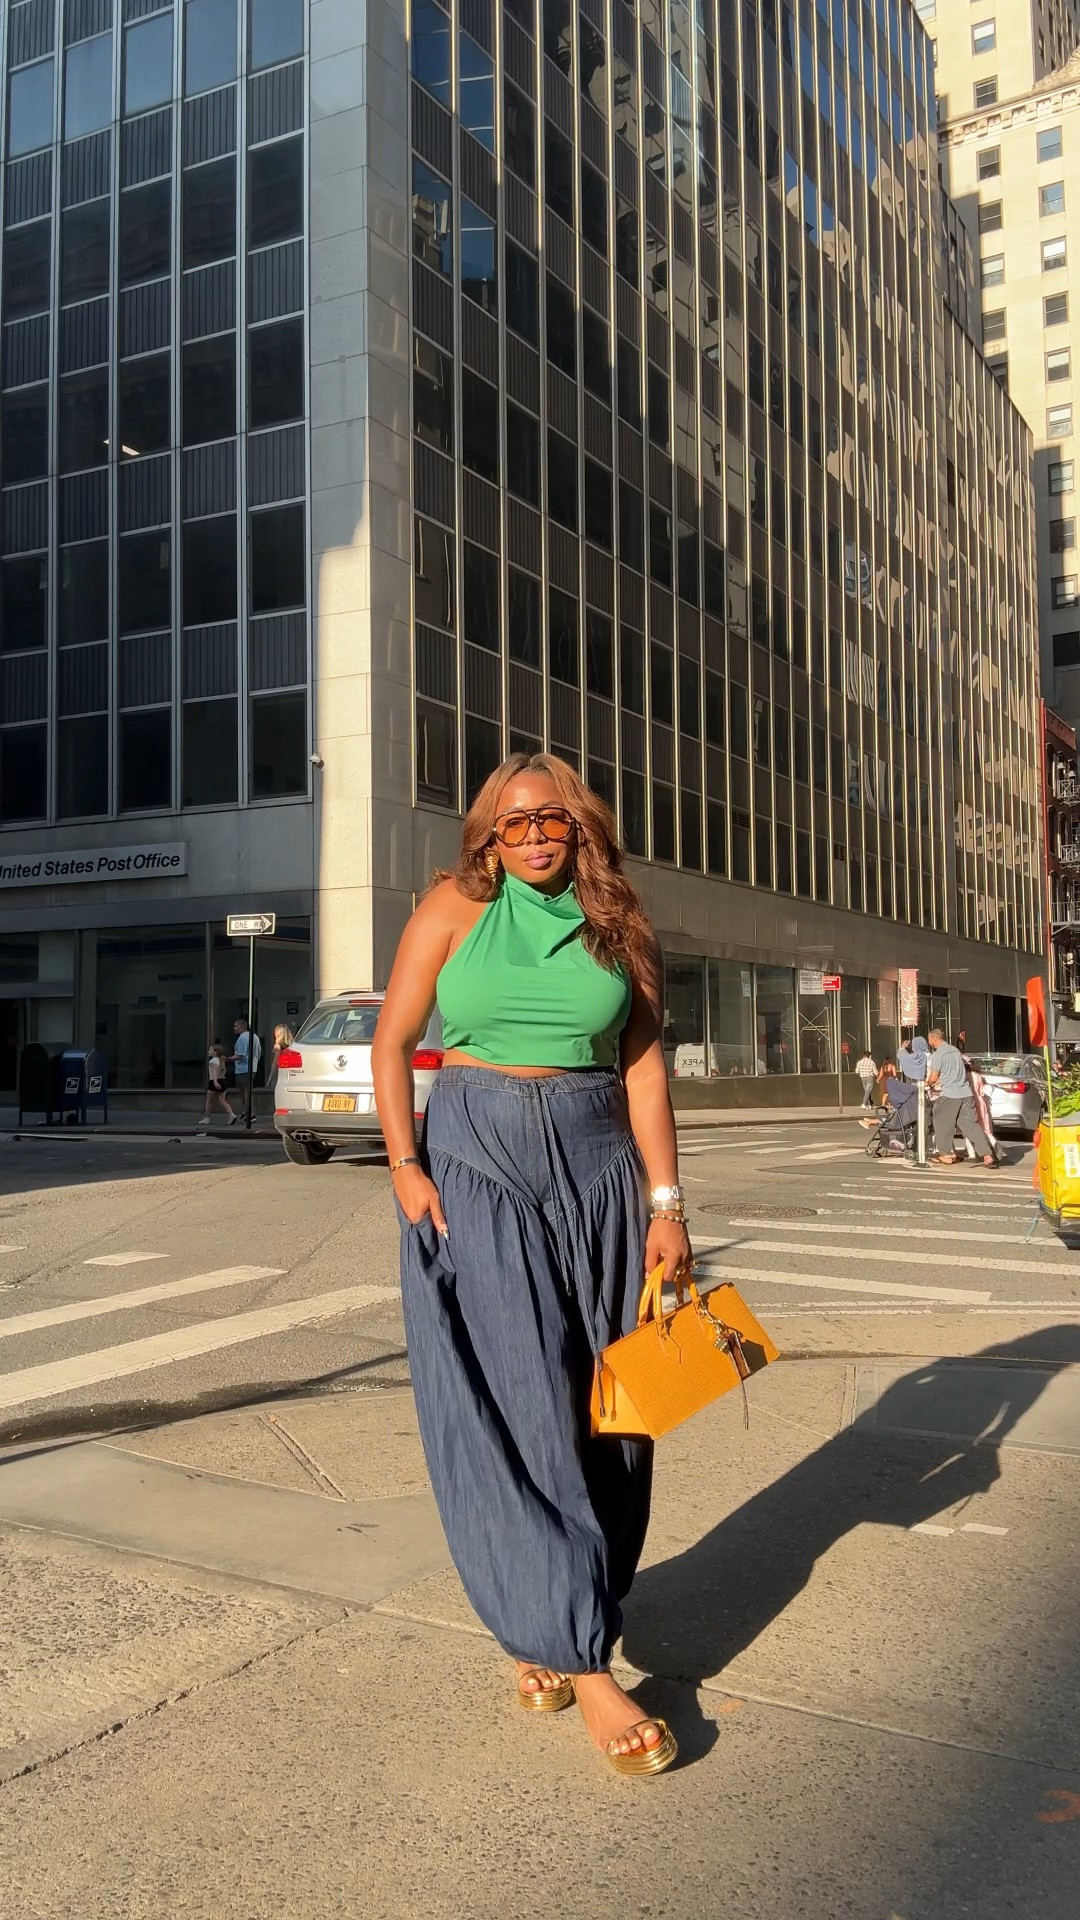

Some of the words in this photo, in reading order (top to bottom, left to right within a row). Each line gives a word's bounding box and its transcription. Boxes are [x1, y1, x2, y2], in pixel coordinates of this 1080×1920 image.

[0, 862, 42, 879] nited
[44, 860, 94, 876] States
[97, 856, 132, 872] Post
[133, 853, 181, 869] Office
[234, 921, 248, 929] ONE
[254, 920, 267, 929] WAY
